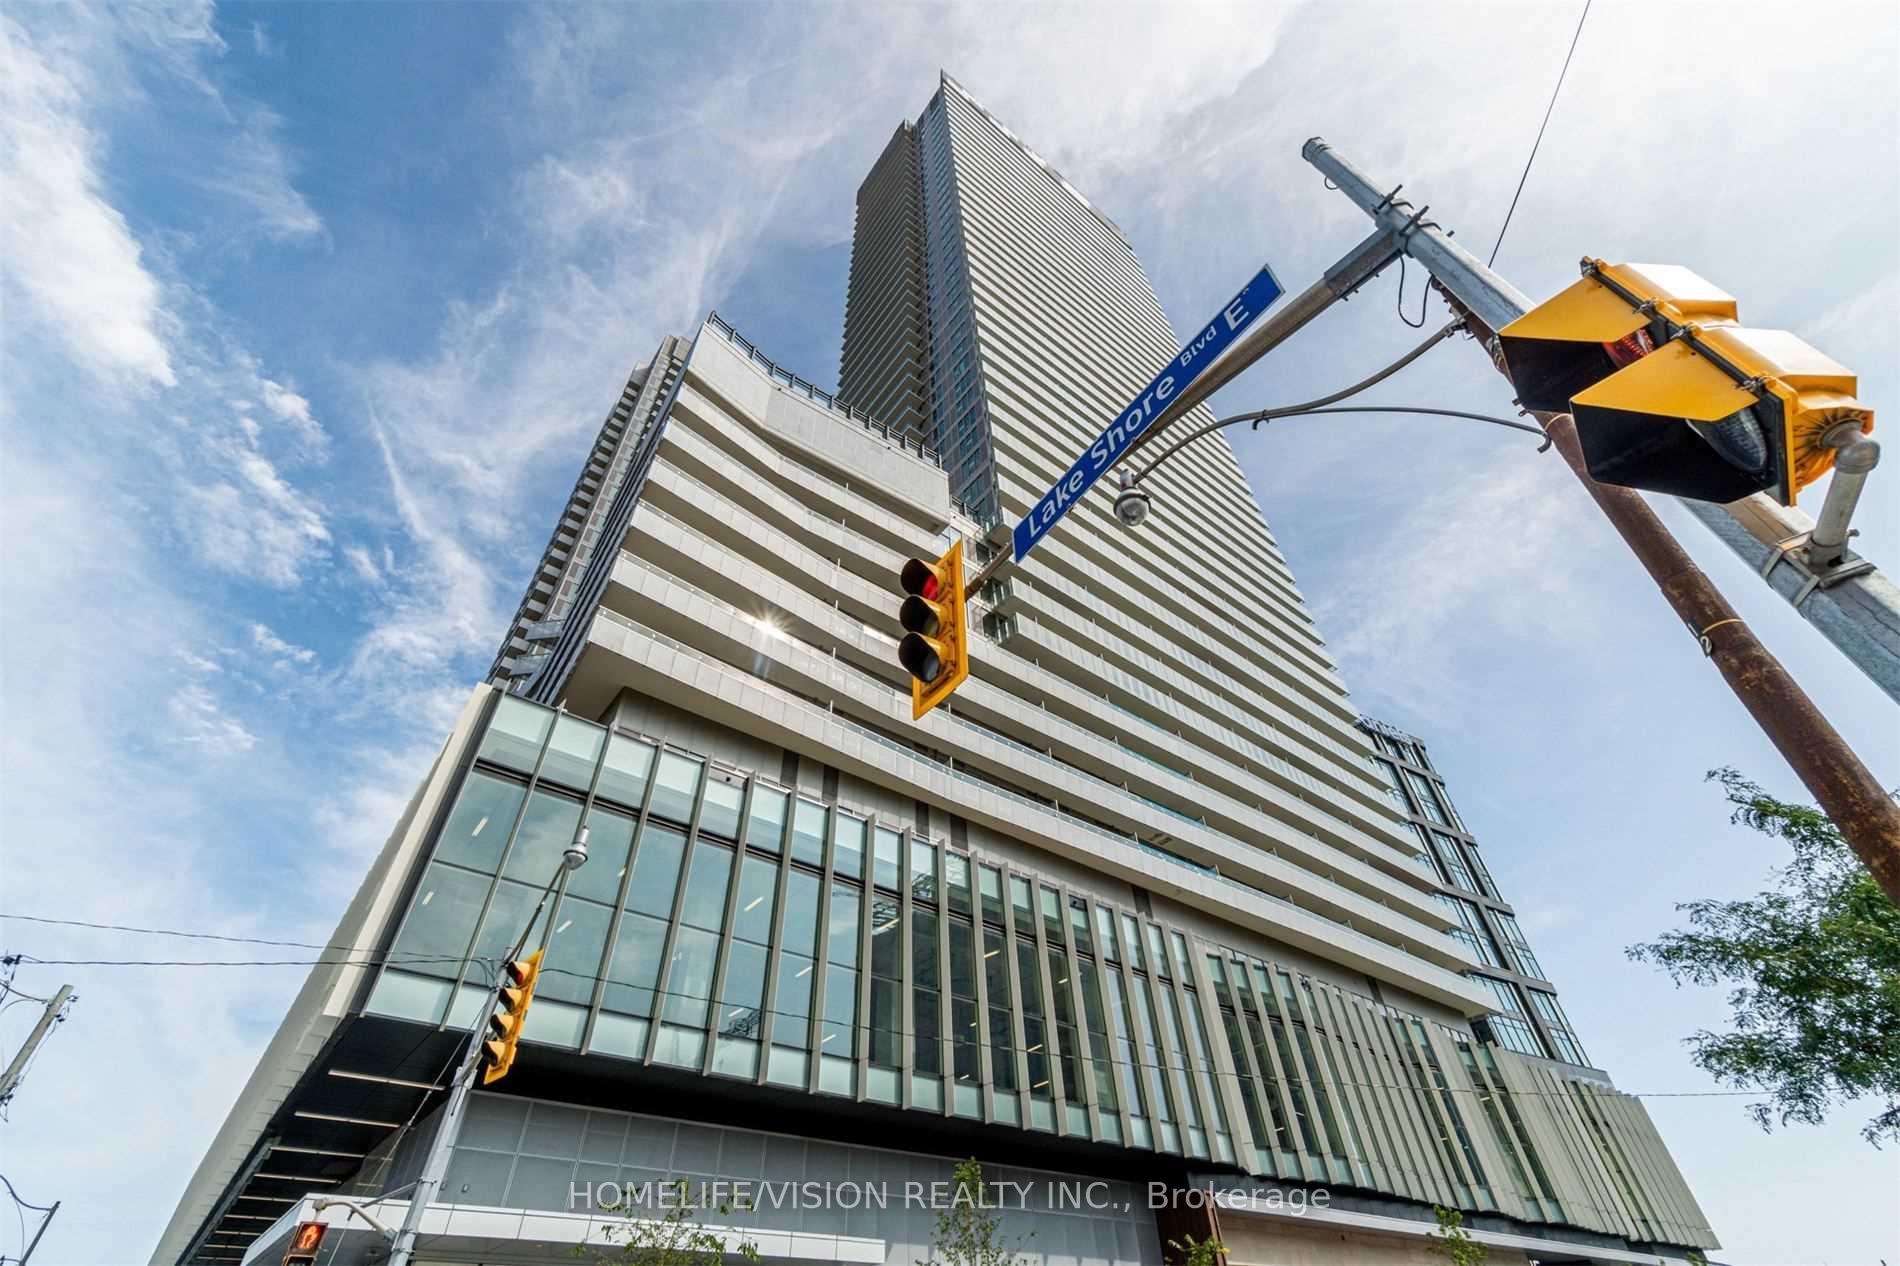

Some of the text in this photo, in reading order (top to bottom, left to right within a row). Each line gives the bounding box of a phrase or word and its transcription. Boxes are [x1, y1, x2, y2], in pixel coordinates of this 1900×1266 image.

[1028, 297, 1250, 539] Lake Shore Blvd E
